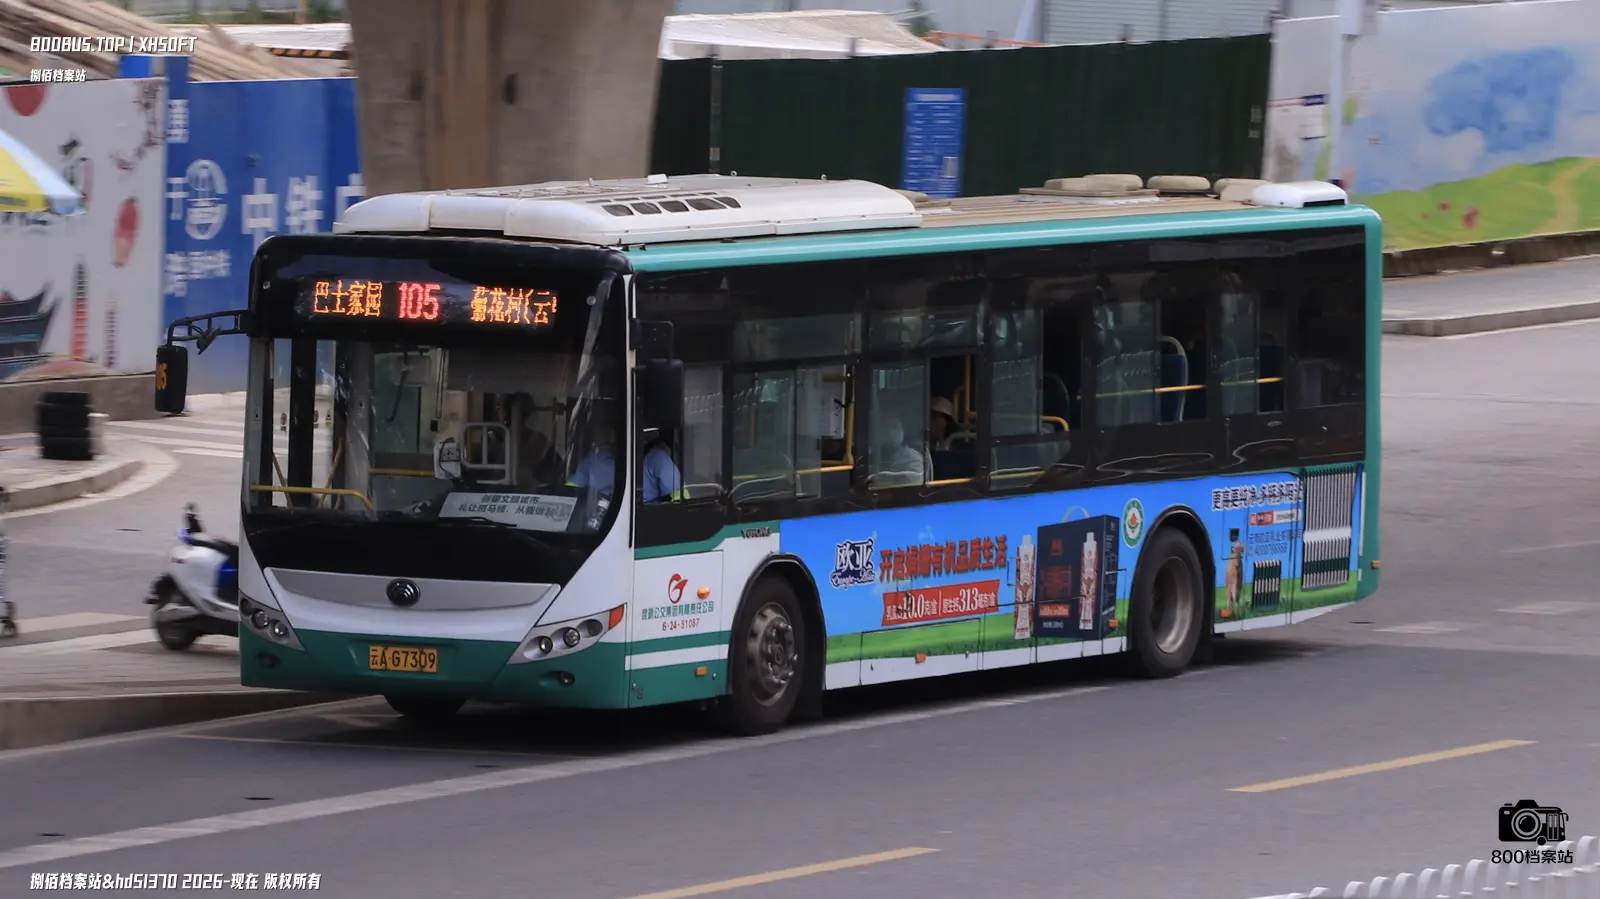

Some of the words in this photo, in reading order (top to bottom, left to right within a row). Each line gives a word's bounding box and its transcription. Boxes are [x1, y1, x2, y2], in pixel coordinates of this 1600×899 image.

[314, 280, 383, 317] 巴士家园
[399, 282, 441, 320] 105
[835, 538, 874, 573] 欧亚
